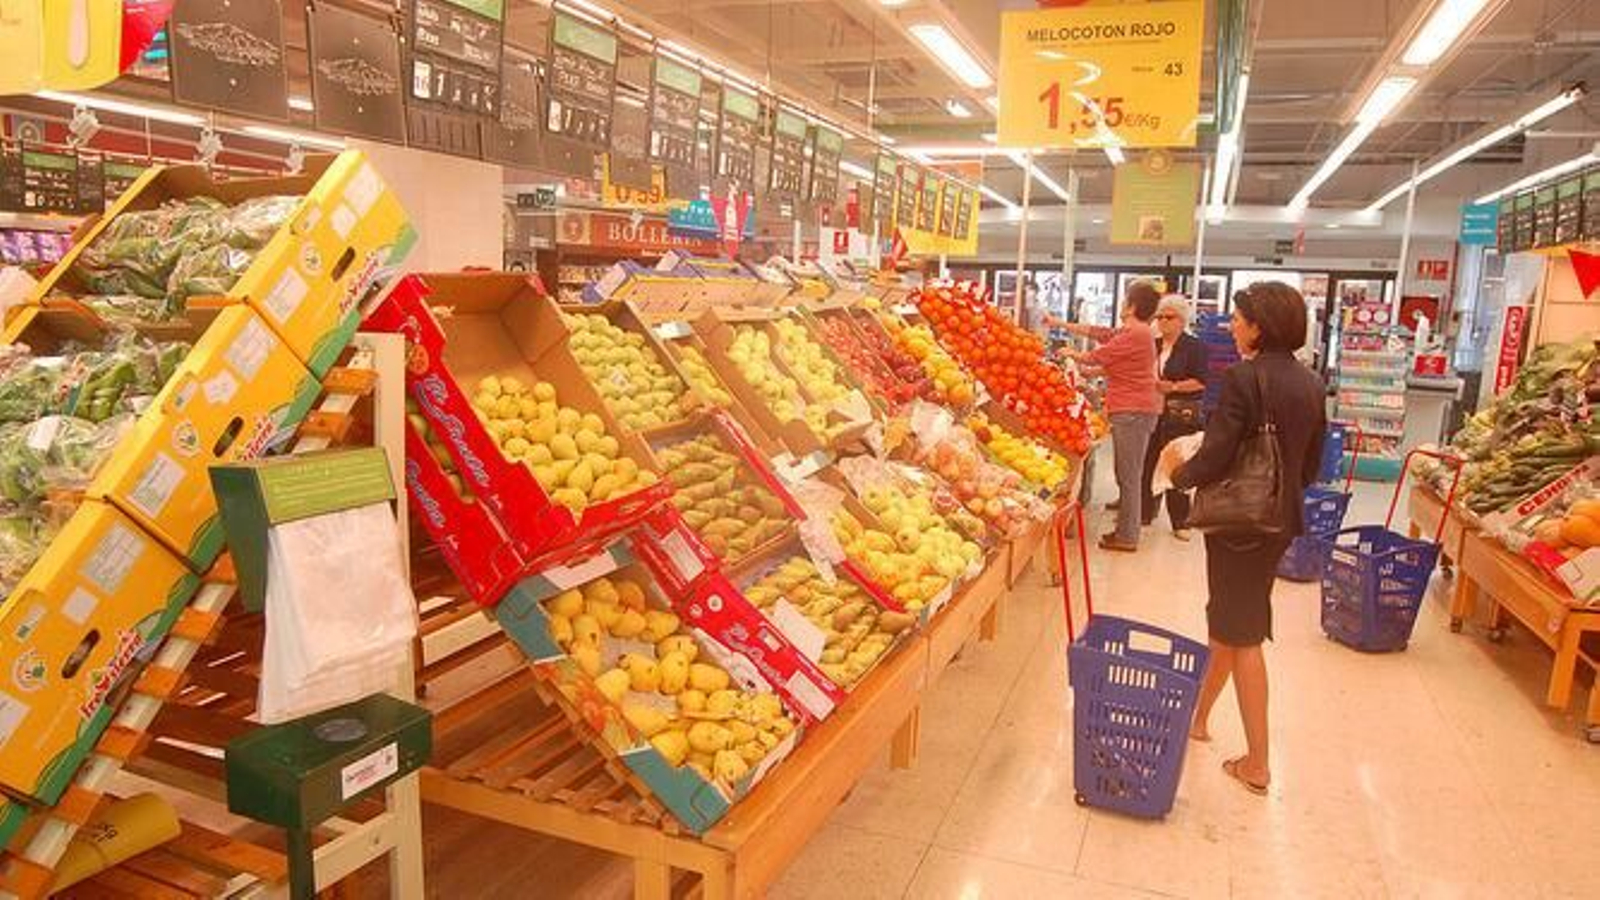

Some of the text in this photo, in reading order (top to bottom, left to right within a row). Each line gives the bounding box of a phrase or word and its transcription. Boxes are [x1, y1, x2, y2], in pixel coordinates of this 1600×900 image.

[1027, 22, 1176, 41] MELOCOTON ROJO
[1164, 62, 1183, 76] 43
